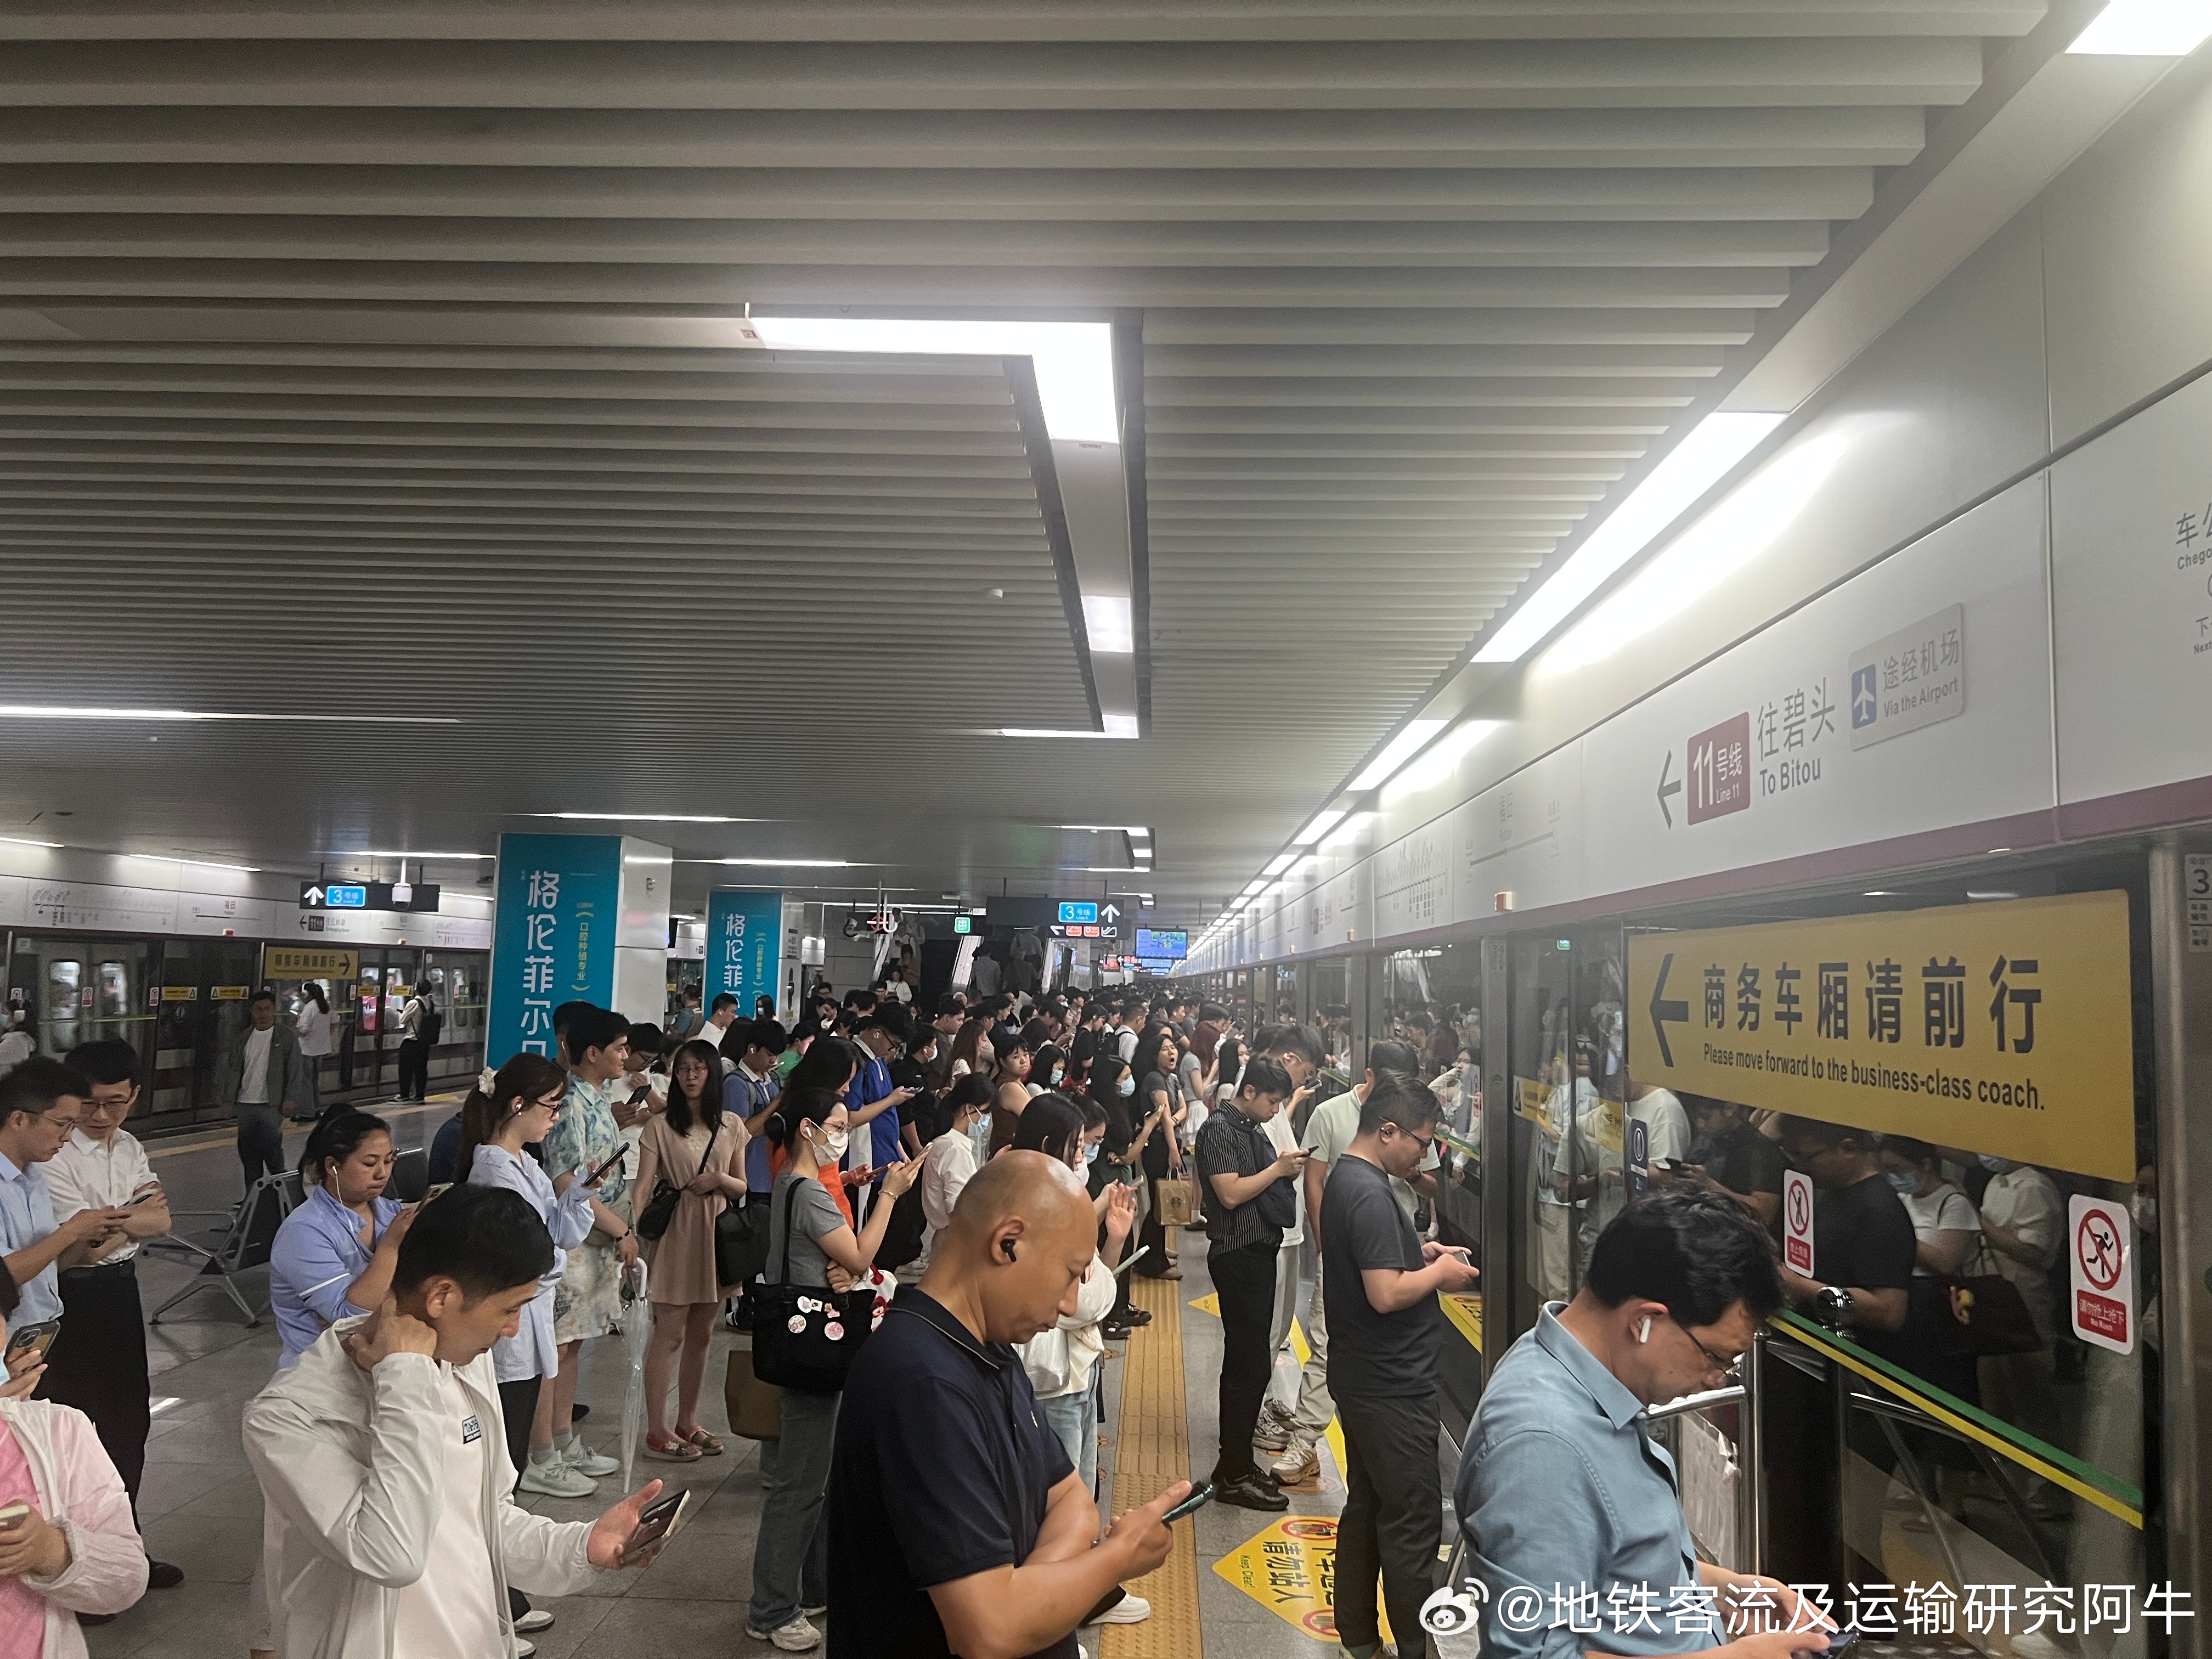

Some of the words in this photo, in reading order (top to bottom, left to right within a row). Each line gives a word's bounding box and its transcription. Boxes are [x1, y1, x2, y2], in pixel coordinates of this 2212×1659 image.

[2196, 616, 2212, 637] 下
[1883, 628, 1959, 692] 途经机场
[1757, 676, 1836, 762] 往碧头
[1884, 701, 1899, 718] Via
[1901, 695, 1917, 712] the
[1920, 676, 1958, 706] Airport
[1716, 787, 1730, 804] Line
[1732, 782, 1740, 799] 11
[1759, 769, 1776, 797] To
[1780, 758, 1820, 791] Bitou
[1703, 955, 2042, 1054] 商务车厢请前行
[1704, 1043, 1734, 1066] Please
[1736, 1051, 1763, 1070] move
[1765, 1049, 1809, 1076] forward
[1812, 1056, 1824, 1079] to
[1827, 1057, 1847, 1082] the
[1852, 1059, 1972, 1100] business-class
[1978, 1078, 2045, 1110] coach.
[1239, 1555, 1251, 1569] Keep
[1263, 1541, 1314, 1604] 请勿站人
